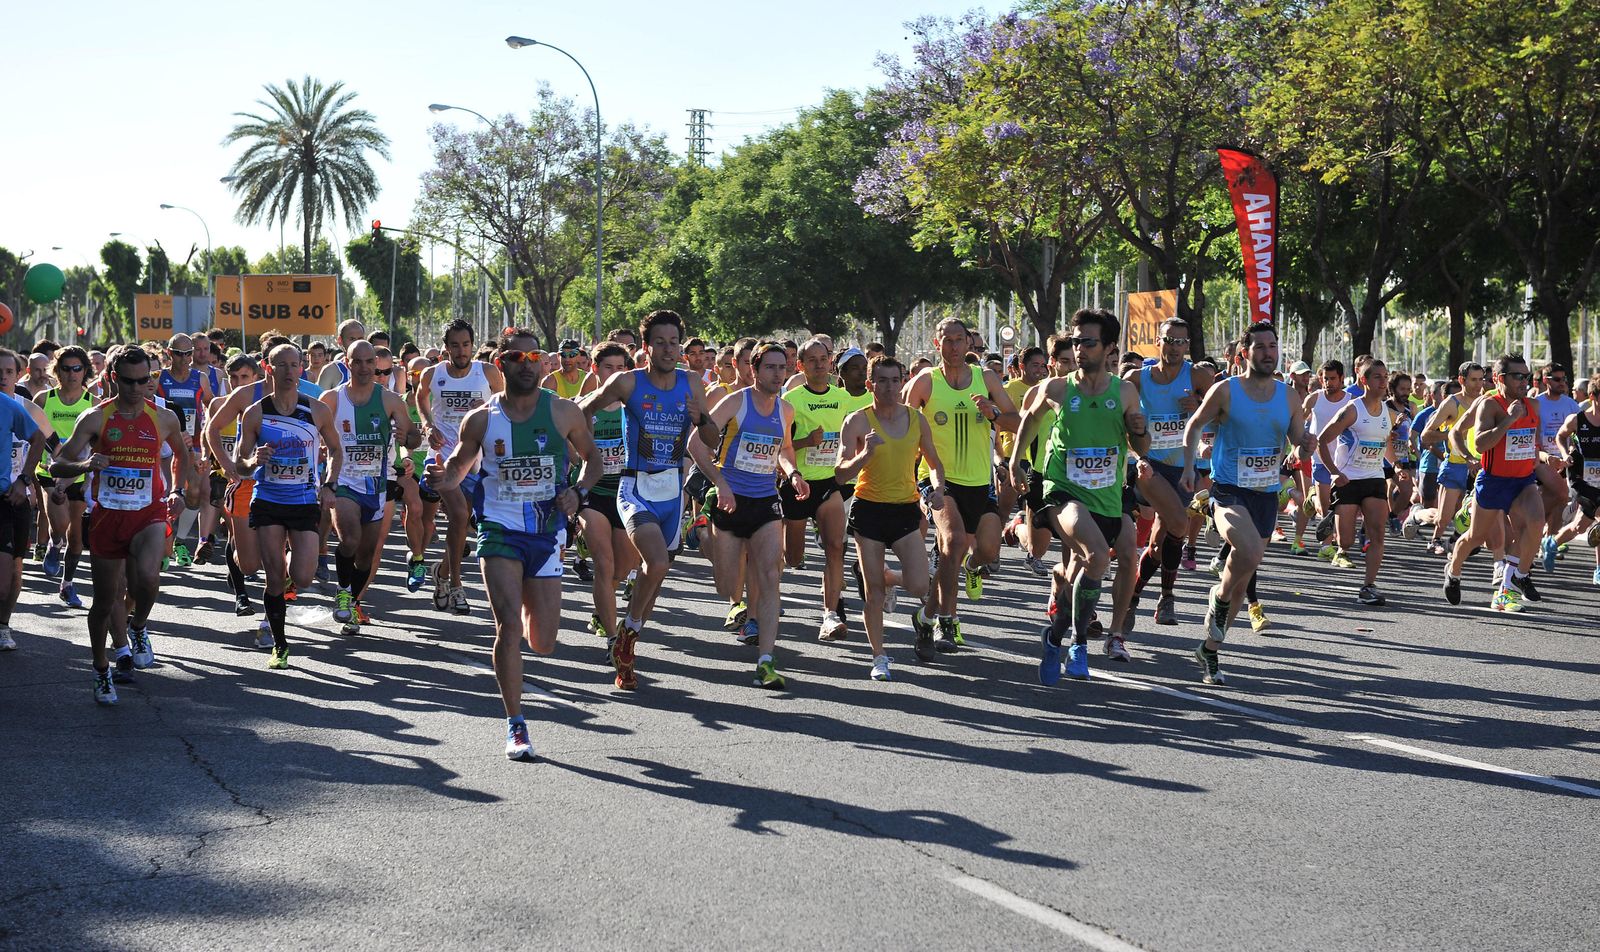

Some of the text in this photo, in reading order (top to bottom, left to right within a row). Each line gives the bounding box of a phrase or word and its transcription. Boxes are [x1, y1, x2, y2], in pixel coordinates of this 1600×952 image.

[248, 304, 291, 319] SUB
[140, 317, 173, 329] SUB
[643, 411, 685, 422] ALI SAAD
[1154, 421, 1185, 431] 0408
[815, 439, 839, 450] 775
[1511, 434, 1533, 445] 2432
[111, 445, 149, 454] atletismo
[652, 439, 675, 455] ibp
[745, 442, 776, 456] 0500
[1361, 446, 1383, 455] 0727
[348, 452, 382, 462] 10294
[1075, 456, 1112, 469] 0026
[1245, 455, 1277, 468] 0556
[501, 467, 553, 481] 10293
[107, 476, 146, 490] 0040
